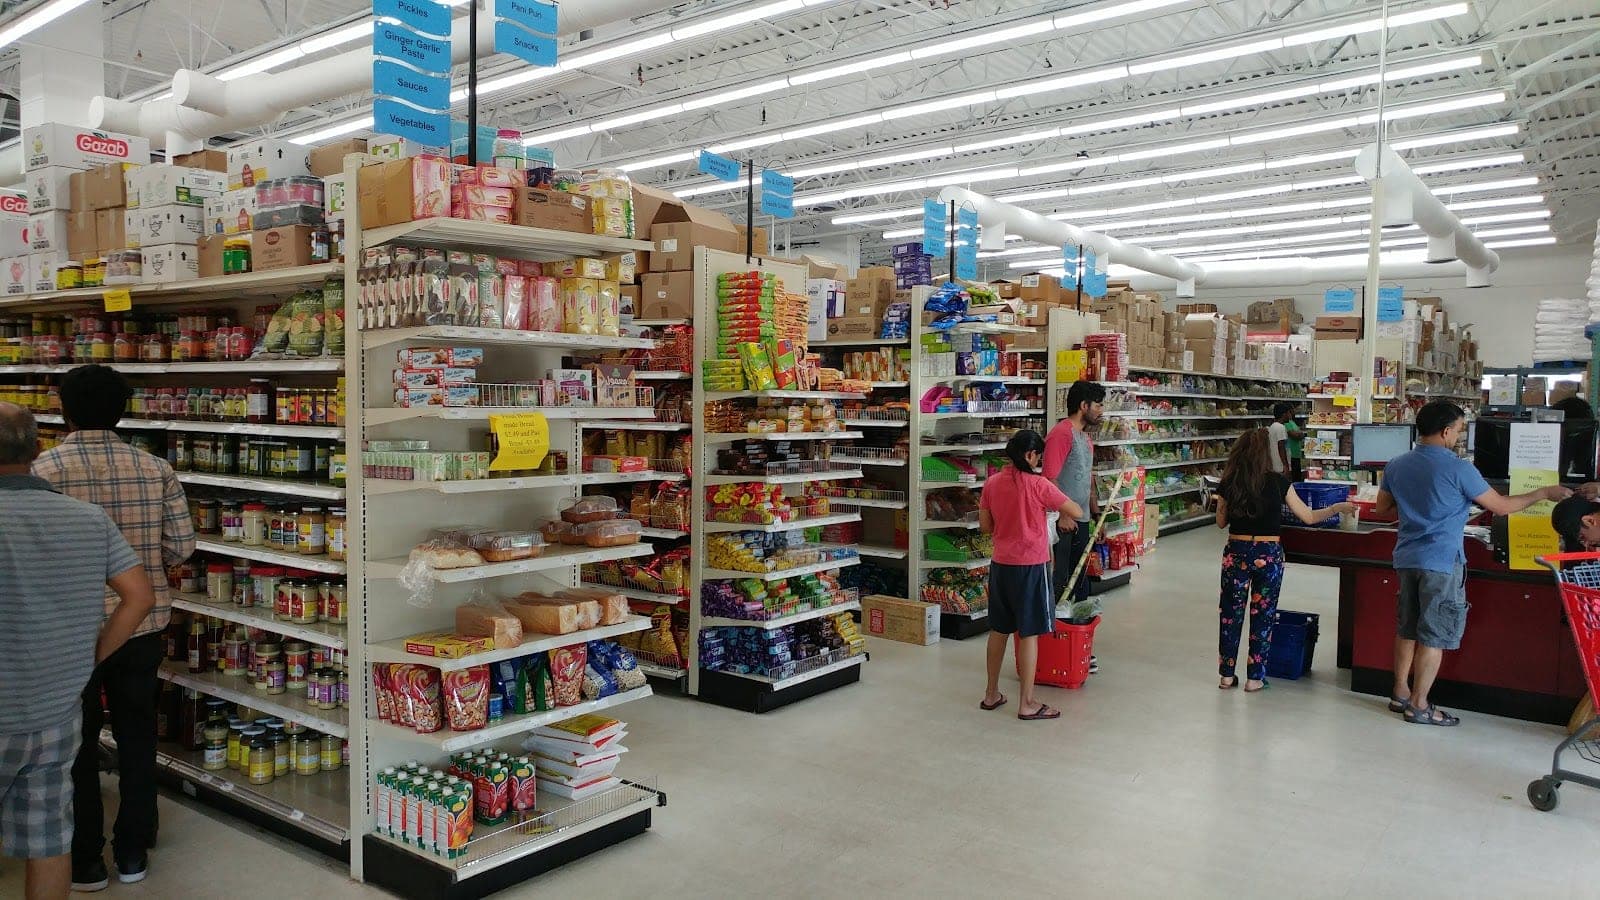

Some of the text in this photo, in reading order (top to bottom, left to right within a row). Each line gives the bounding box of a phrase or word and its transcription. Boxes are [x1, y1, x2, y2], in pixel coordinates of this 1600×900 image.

[398, 2, 429, 18] Pickles
[511, 1, 542, 19] Pani Puri
[384, 30, 441, 55] Ginger Garlic
[514, 37, 540, 53] Snacks
[401, 46, 425, 60] Paste
[397, 78, 429, 94] Sauces
[389, 113, 436, 133] Vegetables
[80, 136, 126, 156] Gazab
